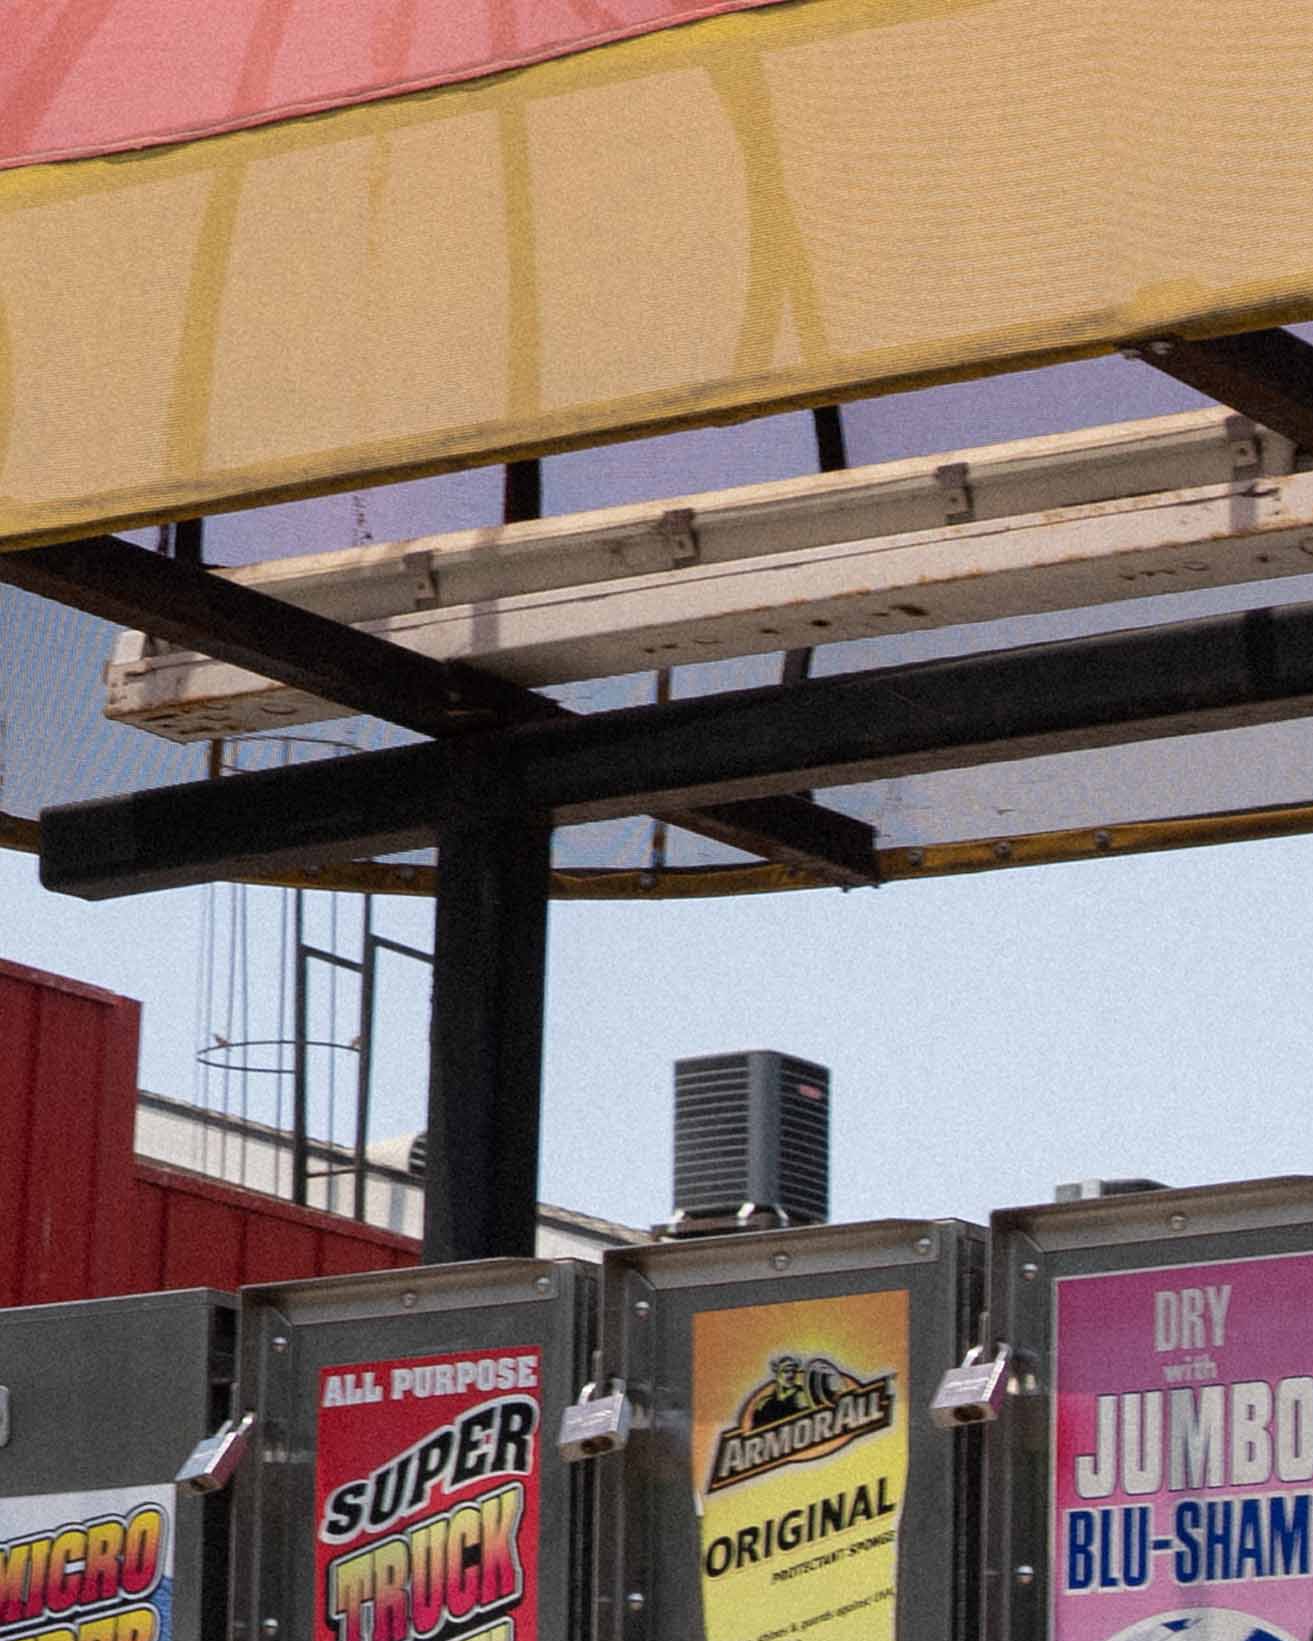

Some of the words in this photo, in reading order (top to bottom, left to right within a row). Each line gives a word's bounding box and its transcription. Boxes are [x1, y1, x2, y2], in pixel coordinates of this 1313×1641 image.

[1153, 1285, 1232, 1352] DRY
[323, 1371, 384, 1408] ALL
[391, 1355, 539, 1401] PURPOSE
[1162, 1354, 1218, 1382] with
[322, 1397, 538, 1538] SUPER
[704, 1477, 897, 1577] ORIGINAL
